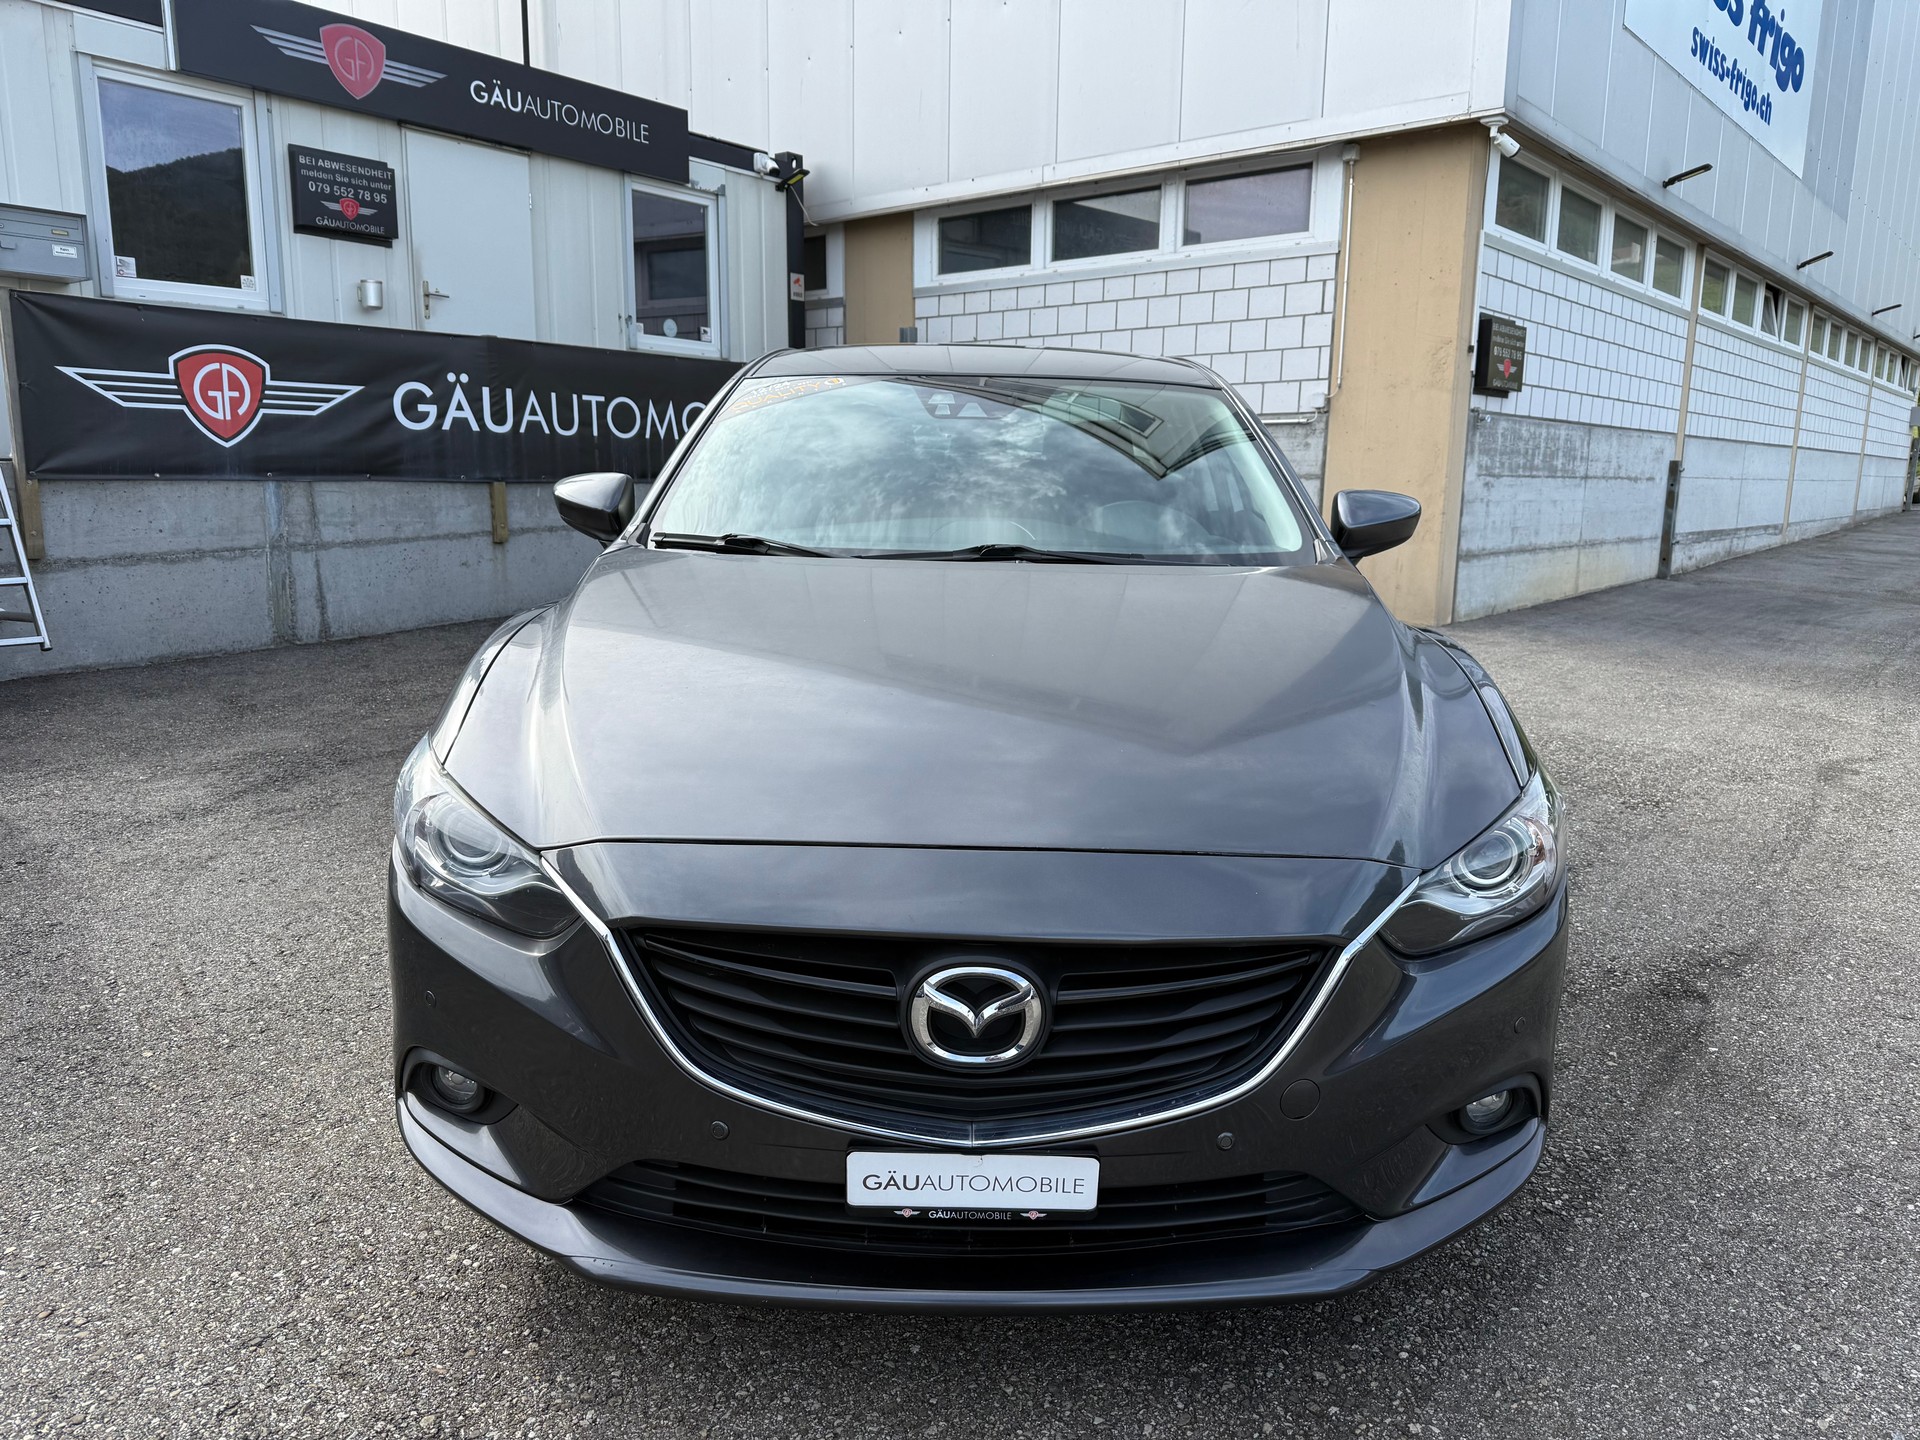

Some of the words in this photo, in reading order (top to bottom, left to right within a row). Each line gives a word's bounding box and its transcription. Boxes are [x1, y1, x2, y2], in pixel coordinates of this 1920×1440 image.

[1747, 0, 1805, 93] frigo
[1690, 26, 1773, 126] swiss-frigo.ch
[469, 79, 649, 144] GÄUAUTOMOBILE
[298, 155, 315, 166] BEI
[317, 158, 393, 180] ABWESENDHEIT
[301, 168, 333, 180] melden
[335, 173, 349, 183] Sie
[350, 176, 368, 187] sich
[370, 181, 392, 191] unter
[308, 180, 330, 194] 079
[333, 185, 354, 198] 552
[357, 189, 371, 201] 78
[373, 193, 387, 204] 95
[315, 215, 385, 235] GÄUAUTOMOBILE
[861, 1170, 1085, 1195] GÄUAUTOMOBILE
[928, 1209, 1012, 1221] GÄUAUTOMOBILE
